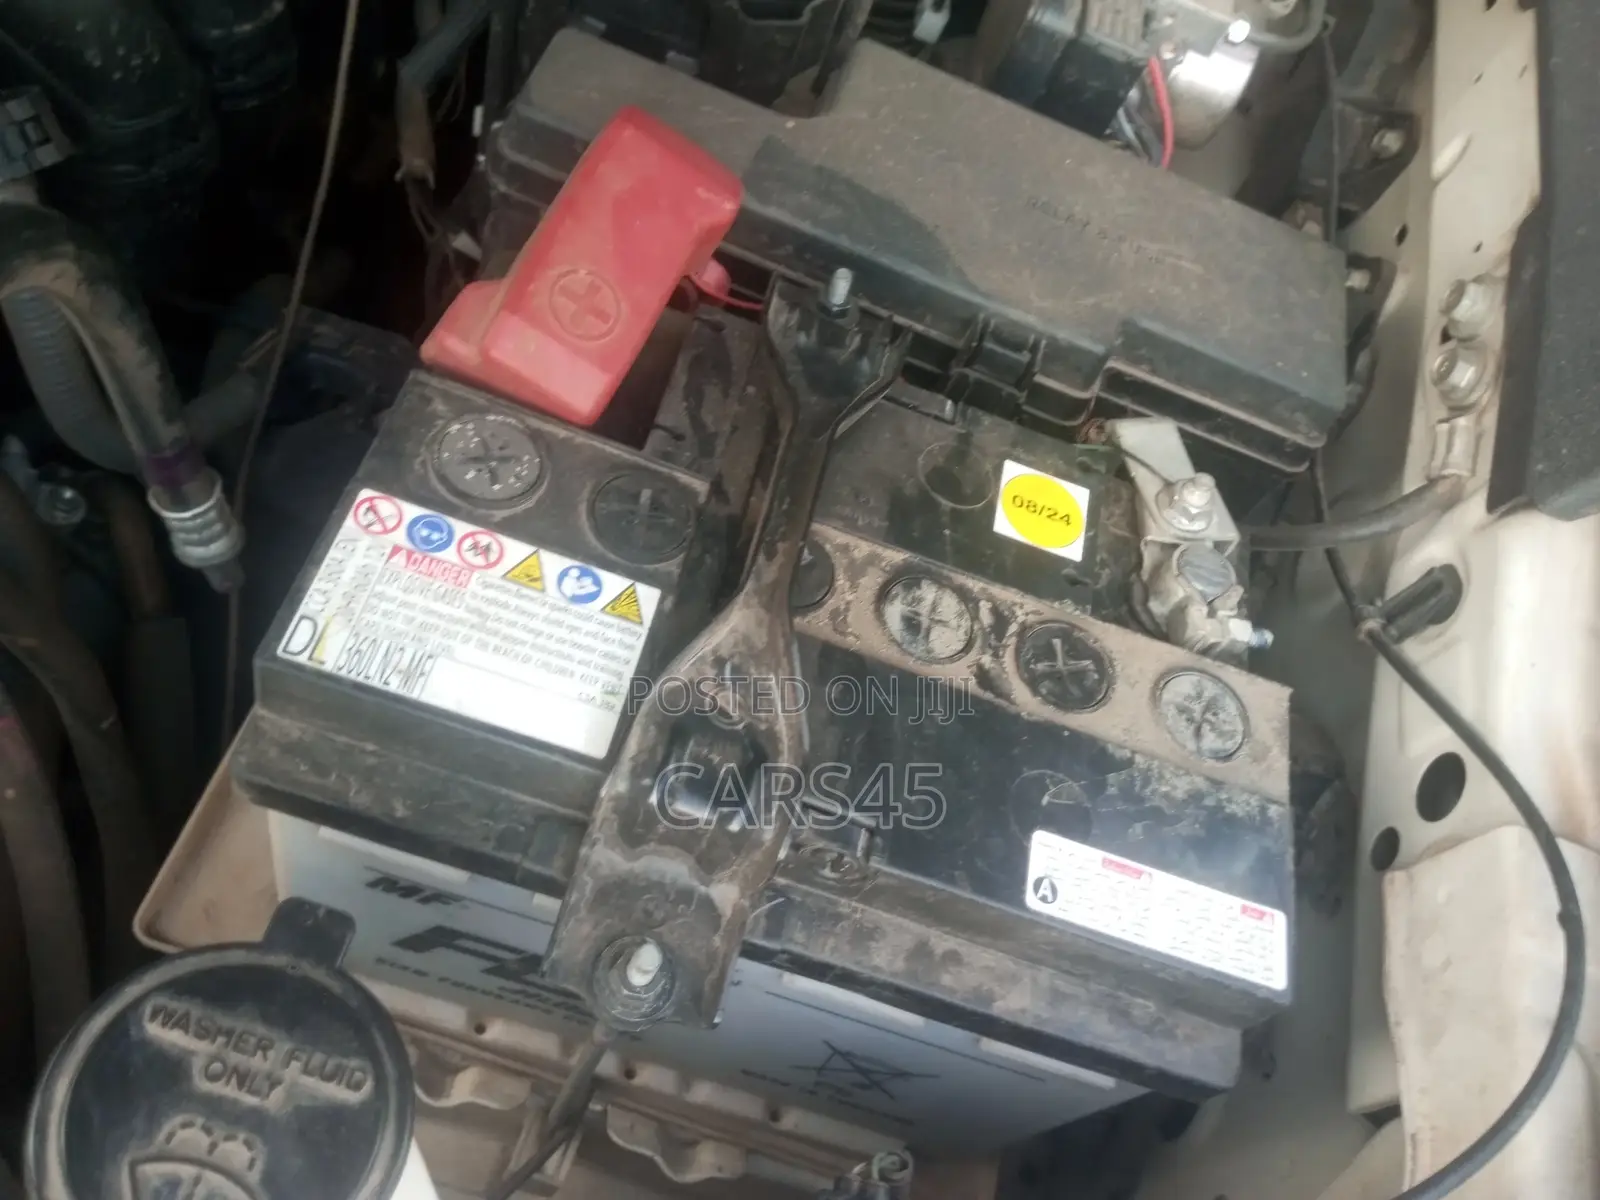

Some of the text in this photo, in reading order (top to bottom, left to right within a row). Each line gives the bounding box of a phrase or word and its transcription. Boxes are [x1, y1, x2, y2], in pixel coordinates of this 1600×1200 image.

[1012, 494, 1072, 527] 08/24
[405, 550, 474, 589] DANGER
[337, 632, 437, 695] 360LN2-MF
[365, 875, 464, 905] MF
[148, 1002, 369, 1094] WASHER FLUID
[203, 1055, 285, 1102] ONLY
